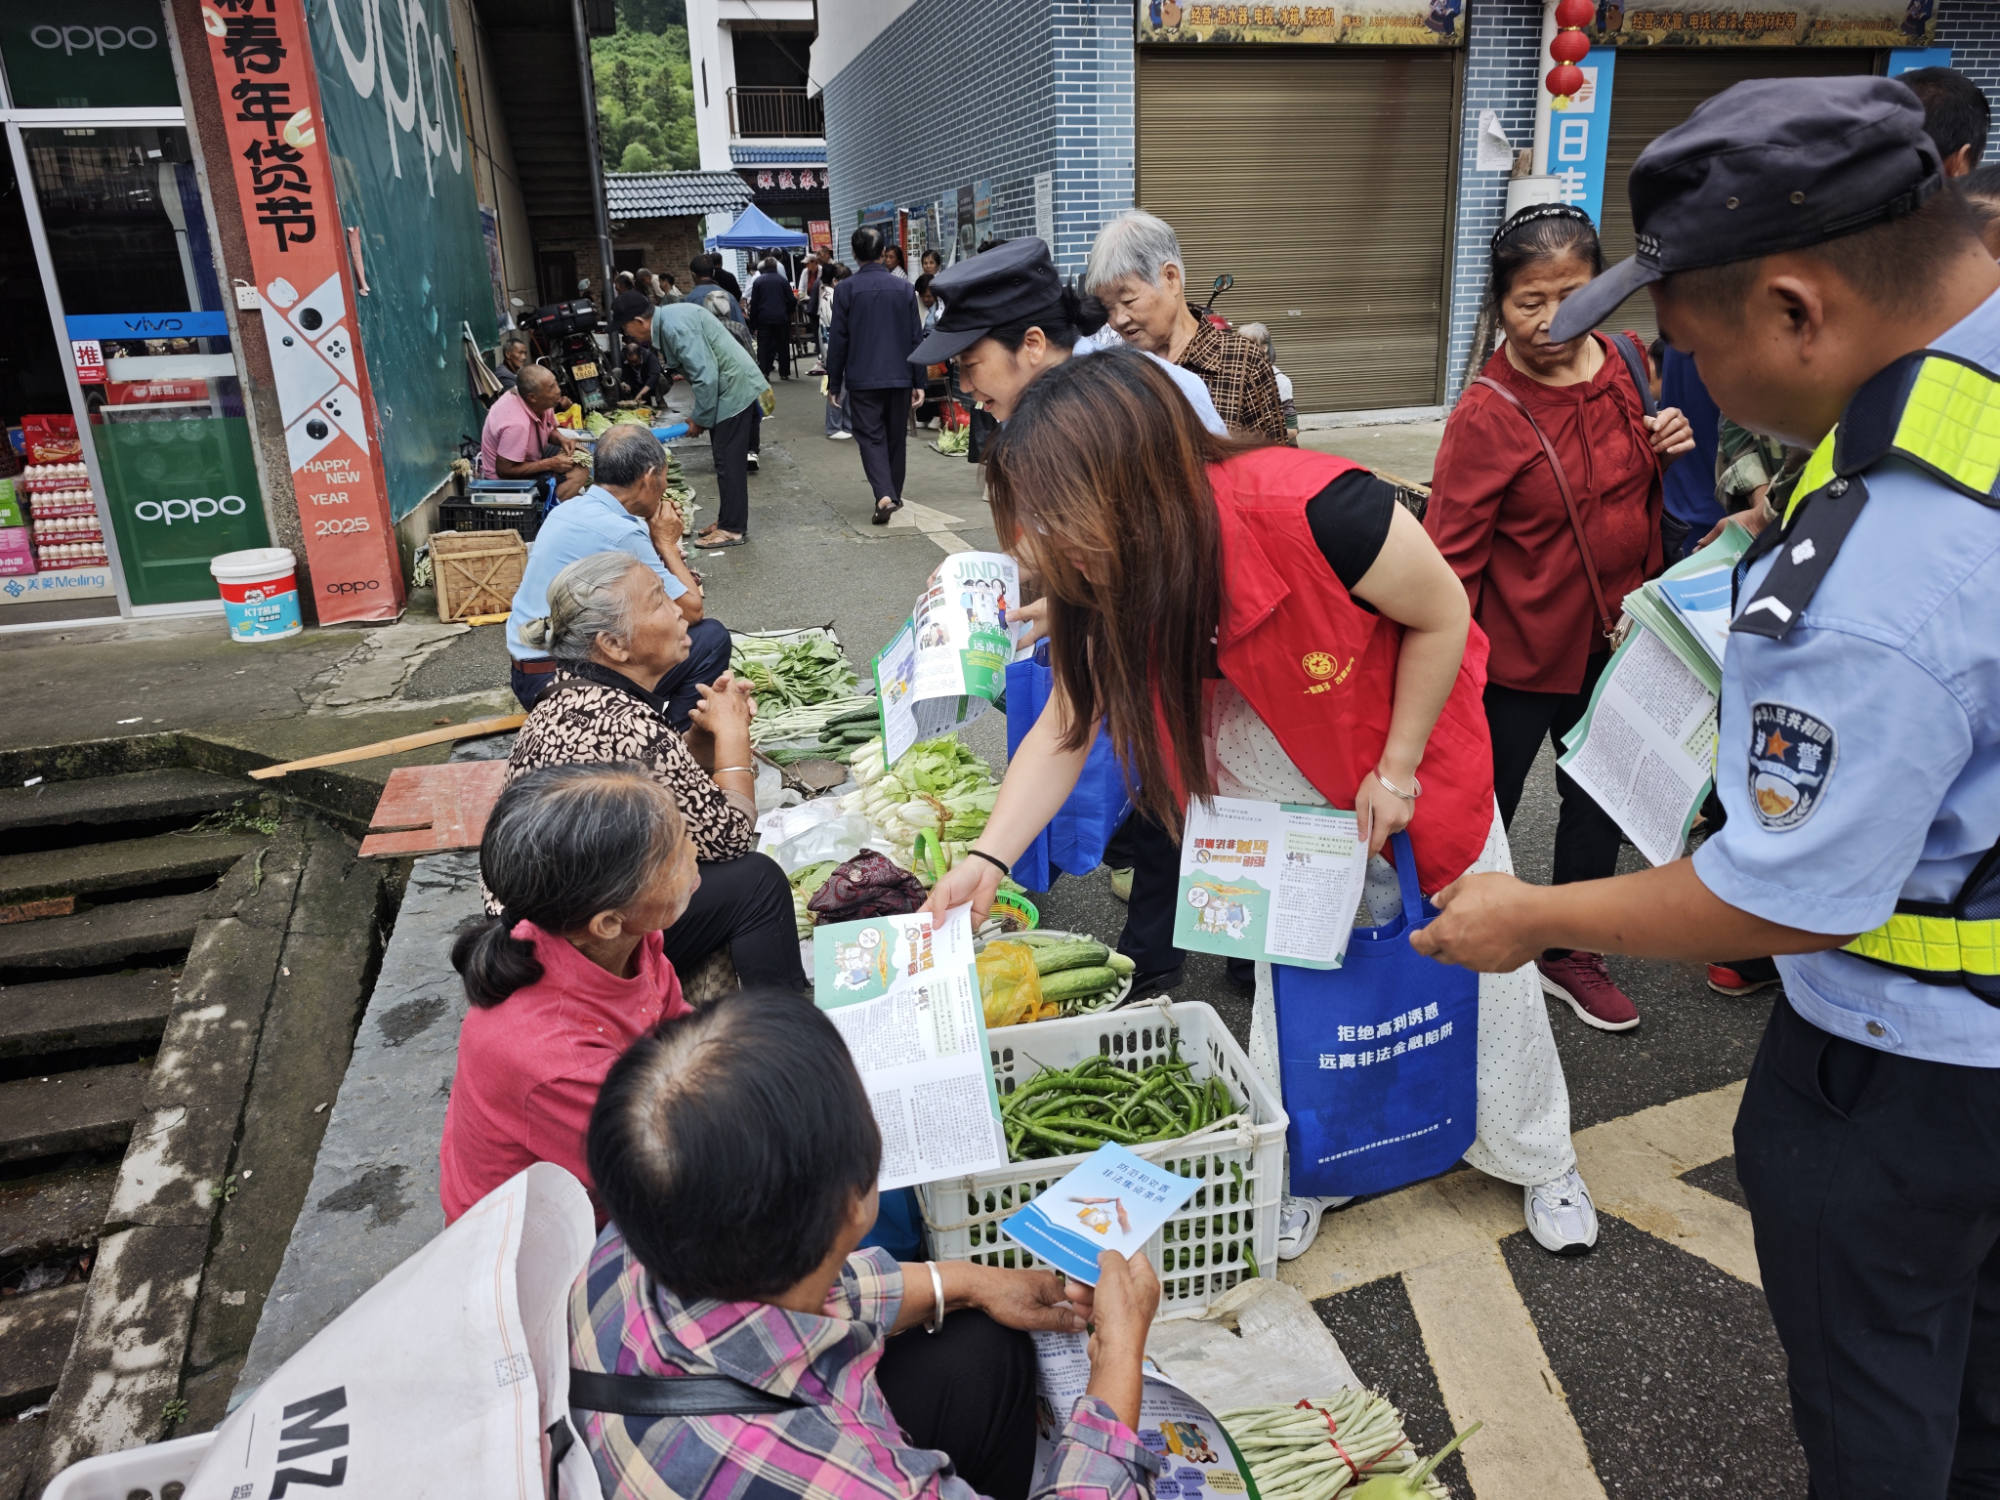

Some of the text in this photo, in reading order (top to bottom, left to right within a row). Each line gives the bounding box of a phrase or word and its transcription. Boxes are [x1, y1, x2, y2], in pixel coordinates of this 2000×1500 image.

[30, 25, 158, 56] oppo
[214, 0, 316, 252] 春年货节
[124, 317, 183, 331] vivo
[76, 345, 101, 365] 推
[303, 459, 351, 473] HAPPY
[326, 471, 360, 484] NEW
[135, 495, 246, 525] oppo
[309, 492, 349, 505] YEAR
[314, 517, 370, 535] 2025
[55, 574, 105, 588] Meiling
[326, 580, 380, 595] oppo
[1796, 742, 1823, 772] 警
[1337, 1001, 1439, 1042] 拒绝高利诱惑
[1318, 1021, 1453, 1069] 远离非法金融陷阱
[1102, 1168, 1167, 1204] 非法集资条例
[1116, 1162, 1171, 1193] 防范和处置
